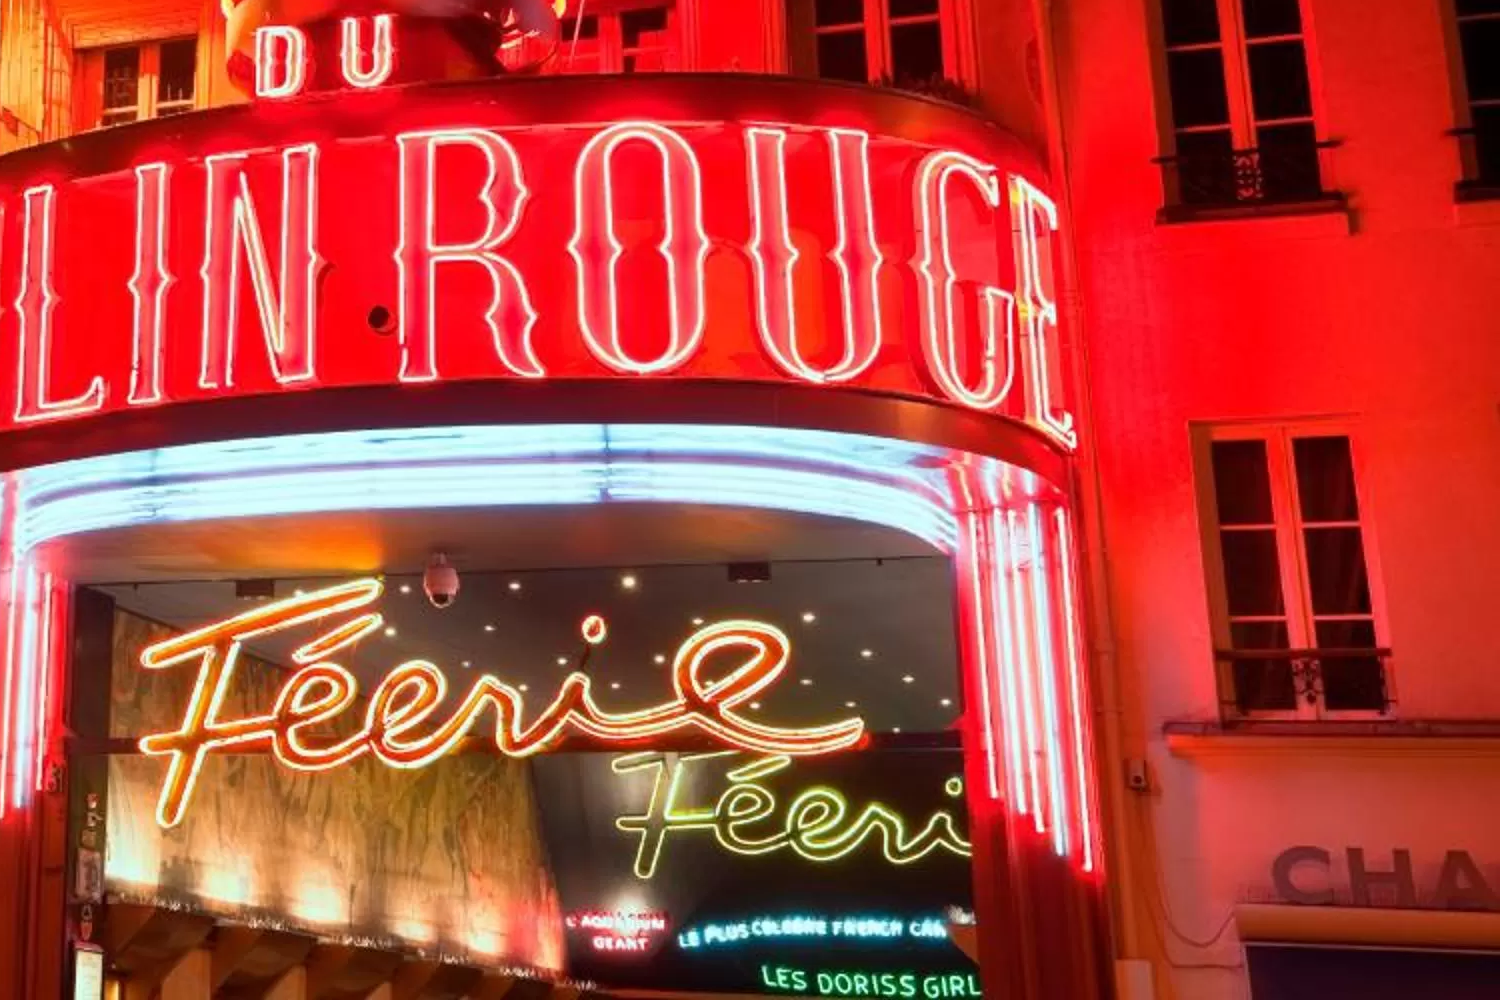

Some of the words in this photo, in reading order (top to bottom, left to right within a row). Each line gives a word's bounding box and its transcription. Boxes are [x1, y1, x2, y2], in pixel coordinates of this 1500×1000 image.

[255, 13, 393, 97] DU
[394, 121, 1077, 452] ROUGE
[139, 577, 866, 829] Féerie
[1271, 845, 1500, 911] CHA
[703, 923, 750, 944] PLUS
[760, 964, 808, 991] LES
[816, 972, 917, 996] DORISS
